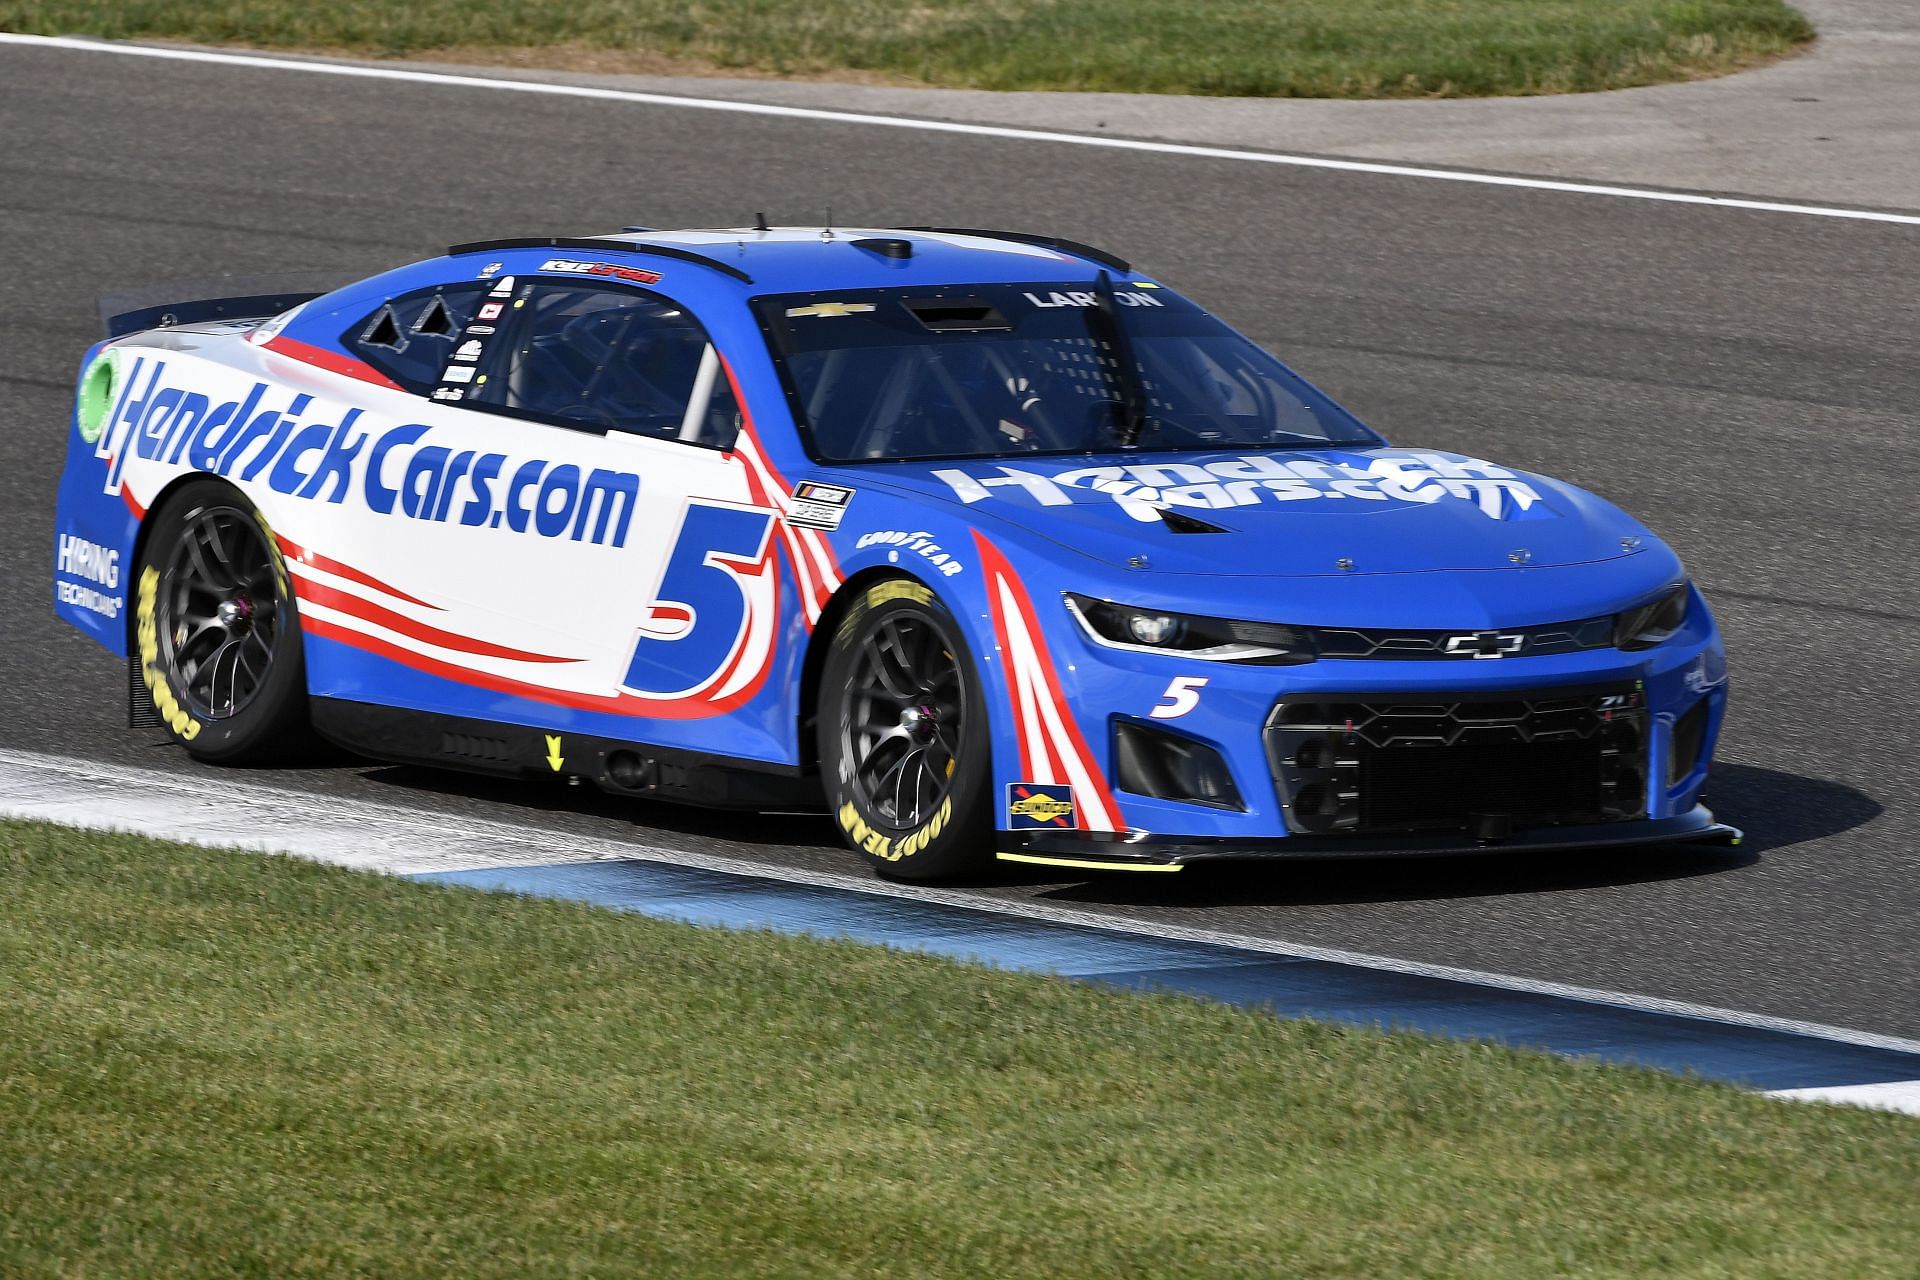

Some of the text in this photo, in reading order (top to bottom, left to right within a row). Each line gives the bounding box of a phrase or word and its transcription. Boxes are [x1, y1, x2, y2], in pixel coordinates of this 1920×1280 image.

[58, 534, 119, 589] HIRING
[616, 497, 774, 701] 5
[1149, 675, 1209, 719] 5
